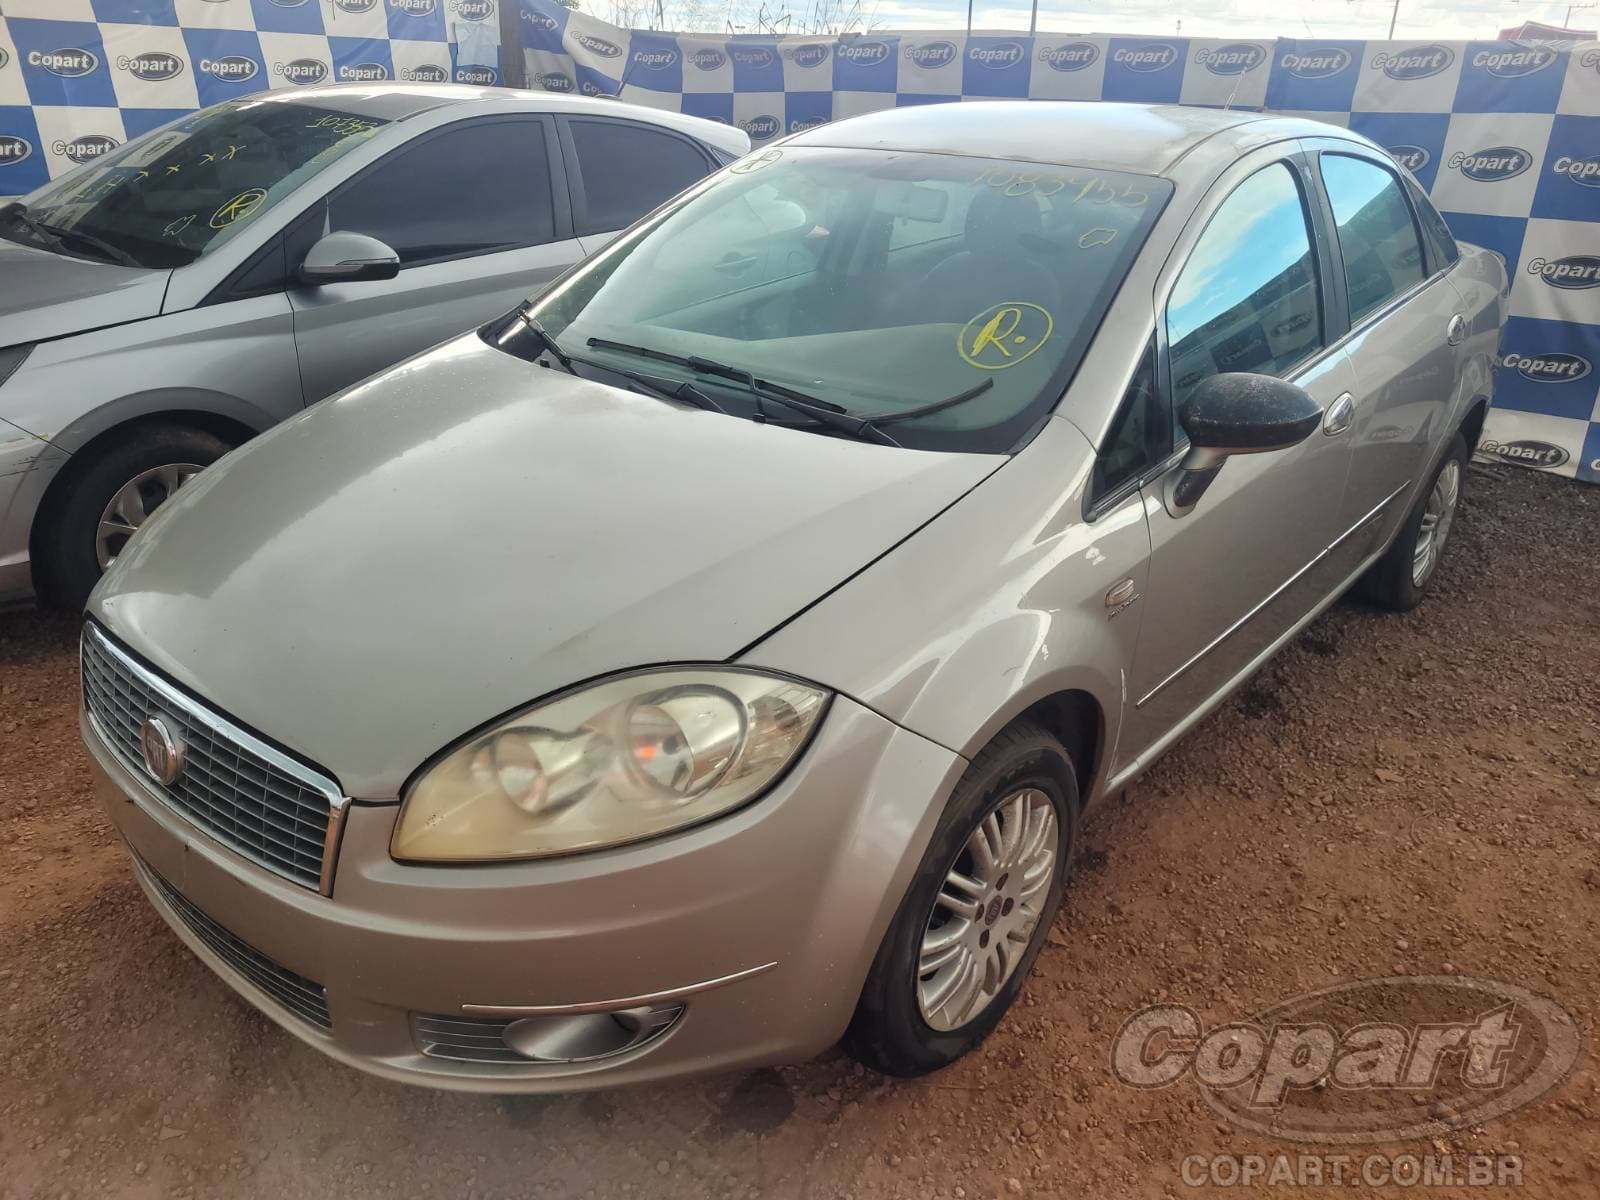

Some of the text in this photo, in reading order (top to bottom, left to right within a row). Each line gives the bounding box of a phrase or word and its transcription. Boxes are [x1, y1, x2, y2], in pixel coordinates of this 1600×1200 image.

[570, 31, 615, 54] Copart
[838, 43, 883, 60] Copart
[28, 51, 90, 69] Copart
[634, 51, 672, 65] Copart
[688, 51, 721, 64] Copart
[904, 44, 949, 63] Copart
[969, 47, 1017, 62] Copart
[1038, 46, 1091, 66] Copart
[1114, 47, 1170, 65] Copart
[1195, 48, 1258, 67] Copart
[1371, 50, 1442, 71] Copart
[1472, 47, 1546, 69] Copart
[117, 55, 175, 72] Copart
[200, 59, 251, 75] Copart
[274, 62, 322, 79] Copart
[339, 65, 383, 81] Copart
[401, 68, 442, 82] Copart
[456, 69, 493, 84] Copart
[52, 139, 112, 157] Copart
[1448, 151, 1520, 172] Copart
[1503, 352, 1582, 375] Copart
[1481, 440, 1559, 462] Copart
